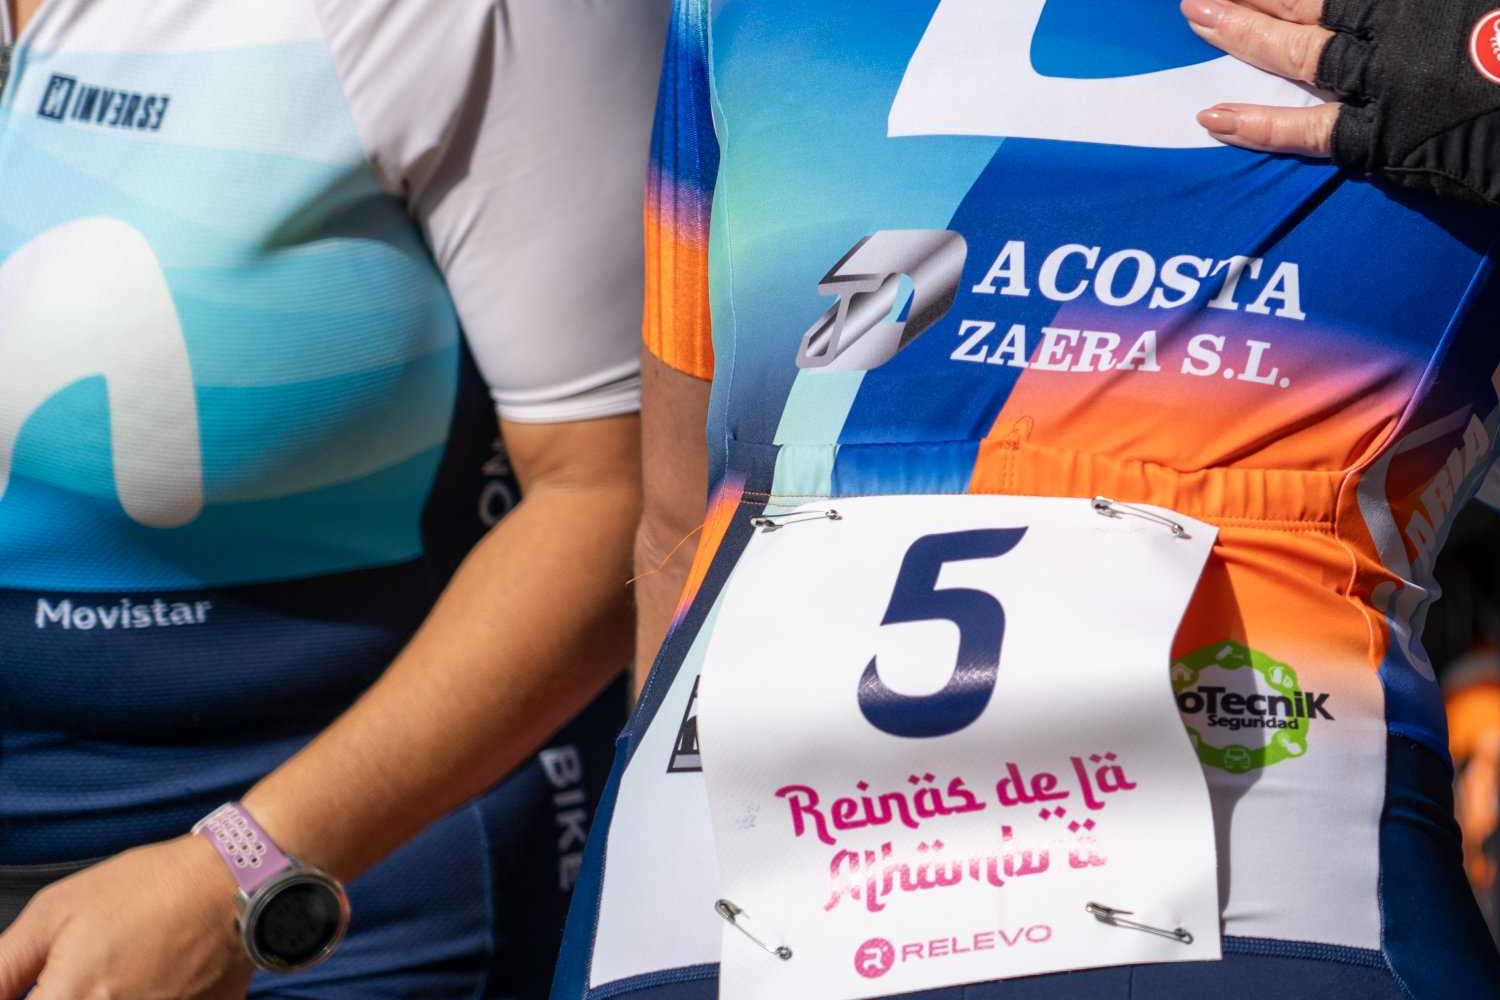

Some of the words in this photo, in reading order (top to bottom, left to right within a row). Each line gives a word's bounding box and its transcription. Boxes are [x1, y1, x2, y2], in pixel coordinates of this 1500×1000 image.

[972, 240, 1307, 321] ACOSTA
[949, 319, 1162, 373] ZAERA
[1182, 333, 1292, 389] S.L.
[34, 597, 213, 631] Movistar
[857, 526, 1029, 739] 5
[1207, 714, 1300, 732] Seguridad
[996, 762, 1070, 807] de
[901, 924, 1053, 963] RELEVO
